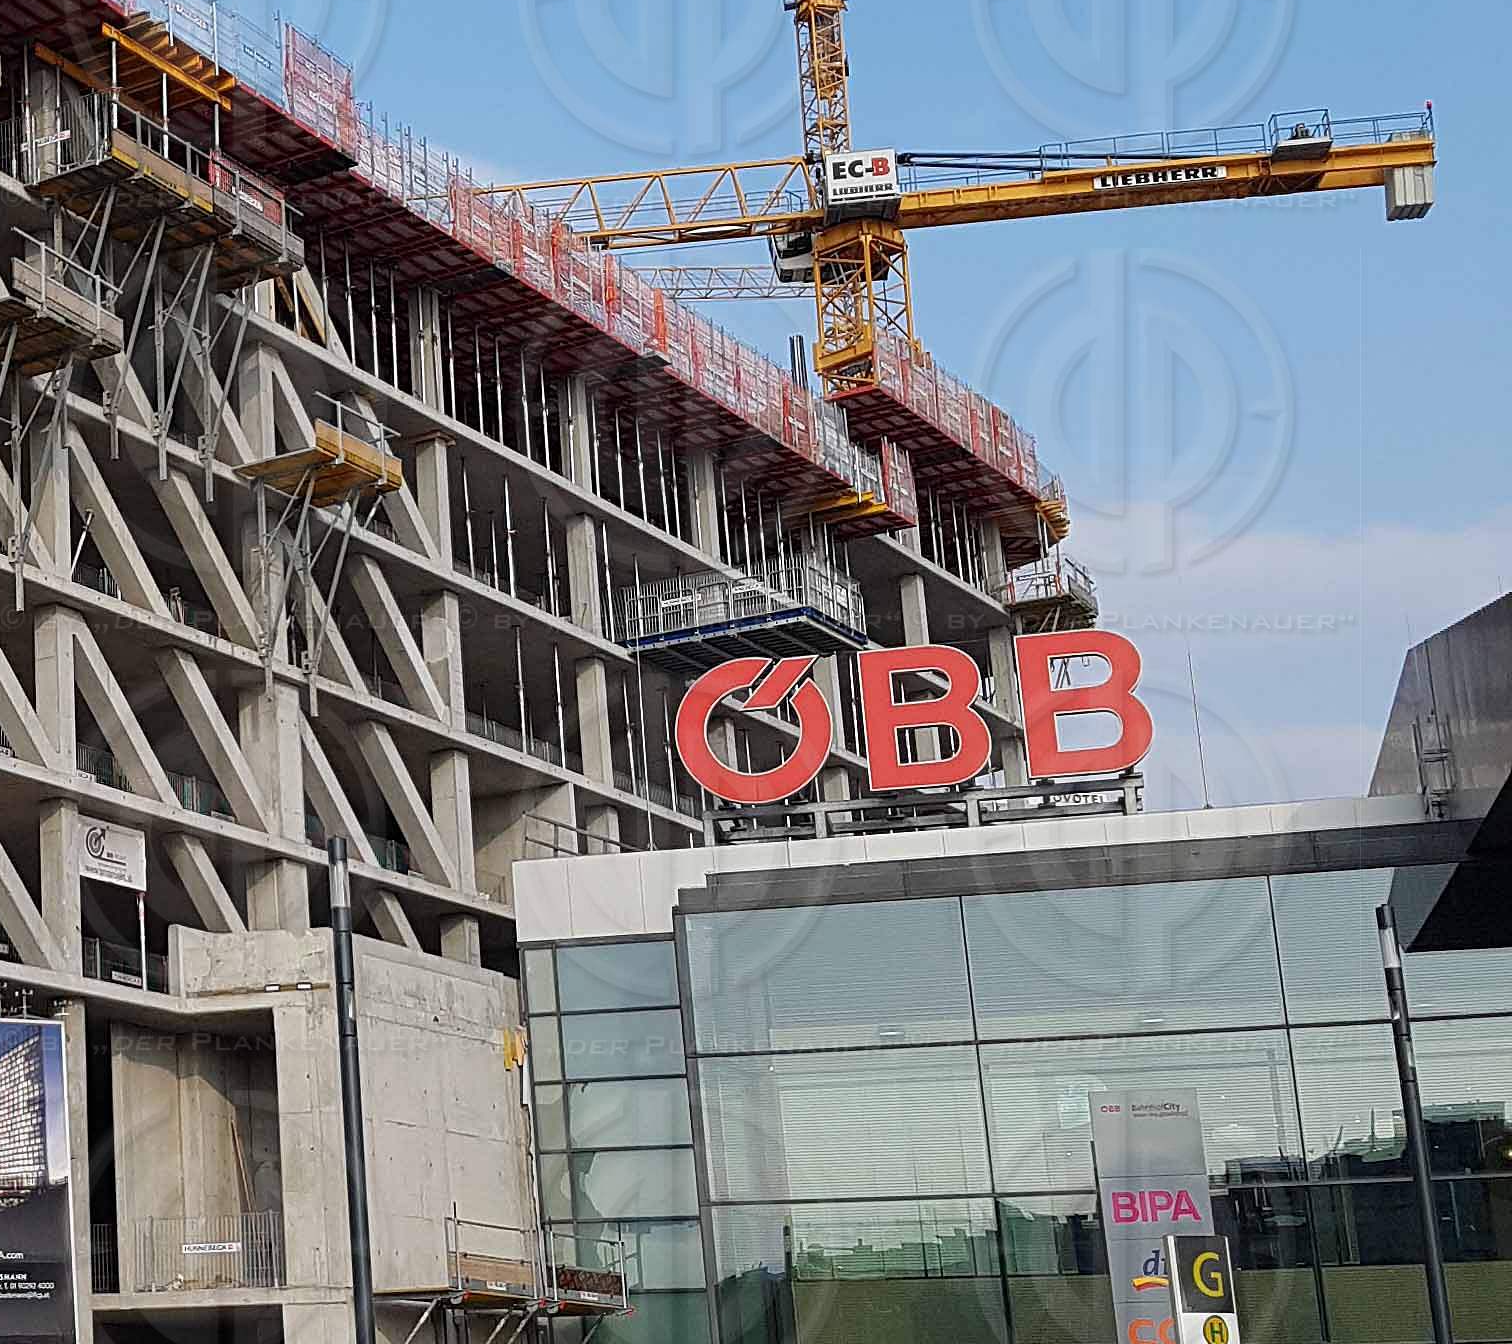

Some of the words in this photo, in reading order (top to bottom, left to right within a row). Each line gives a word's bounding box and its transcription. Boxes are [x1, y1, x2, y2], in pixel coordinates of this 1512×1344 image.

[832, 157, 890, 180] EC-B
[1100, 166, 1218, 189] LIEBHERR
[675, 628, 1155, 805] ÖBB
[1112, 1190, 1201, 1223] BIPA
[1192, 1251, 1224, 1298] G
[1210, 1321, 1224, 1343] H
